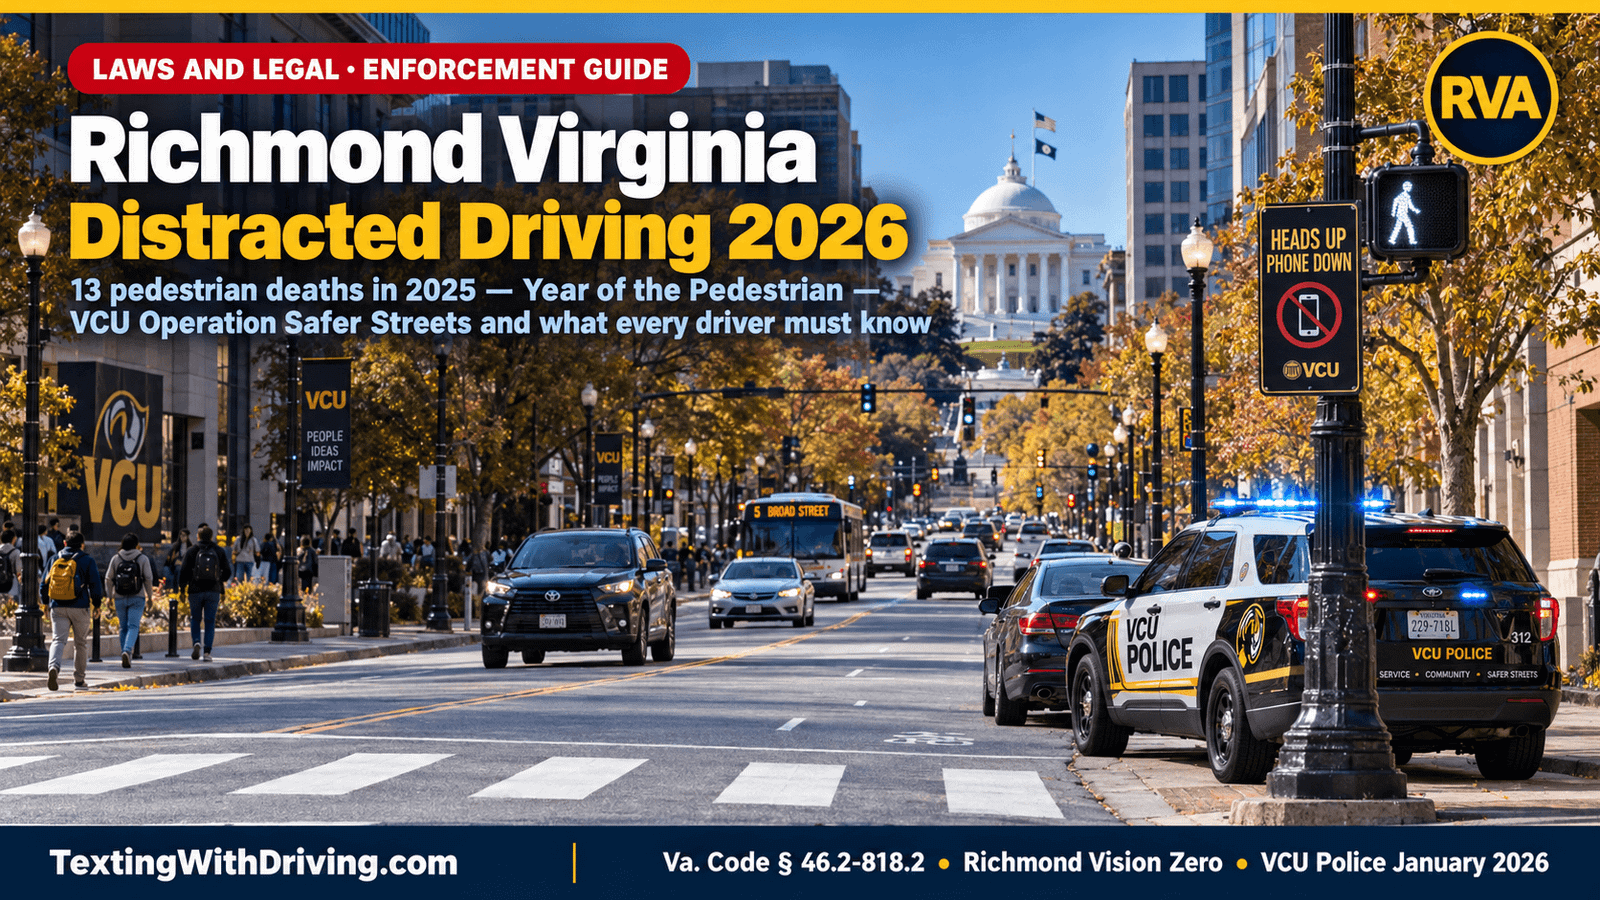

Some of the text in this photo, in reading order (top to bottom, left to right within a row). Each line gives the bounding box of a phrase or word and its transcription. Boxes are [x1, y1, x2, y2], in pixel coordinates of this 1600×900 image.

[1271, 227, 1347, 251] HEADS UP
[1267, 252, 1352, 273] PHONE DOWN
[1302, 362, 1340, 378] VCU
[305, 390, 347, 410] VCU
[306, 430, 344, 443] PEOPLE
[310, 445, 339, 457] IDEAS
[596, 451, 620, 464] VCU
[307, 459, 343, 472] IMPACT
[82, 455, 162, 529] VCU
[753, 505, 830, 518] 5 BROAD STREET
[1126, 615, 1160, 642] VCU
[1411, 619, 1456, 632] 229-718L
[1511, 631, 1532, 644] 312
[1127, 637, 1193, 674] POLICE
[1411, 646, 1493, 660] VCU POLICE
[1379, 670, 1538, 679] SERVICE COMMUNITY SAFER STREETS
